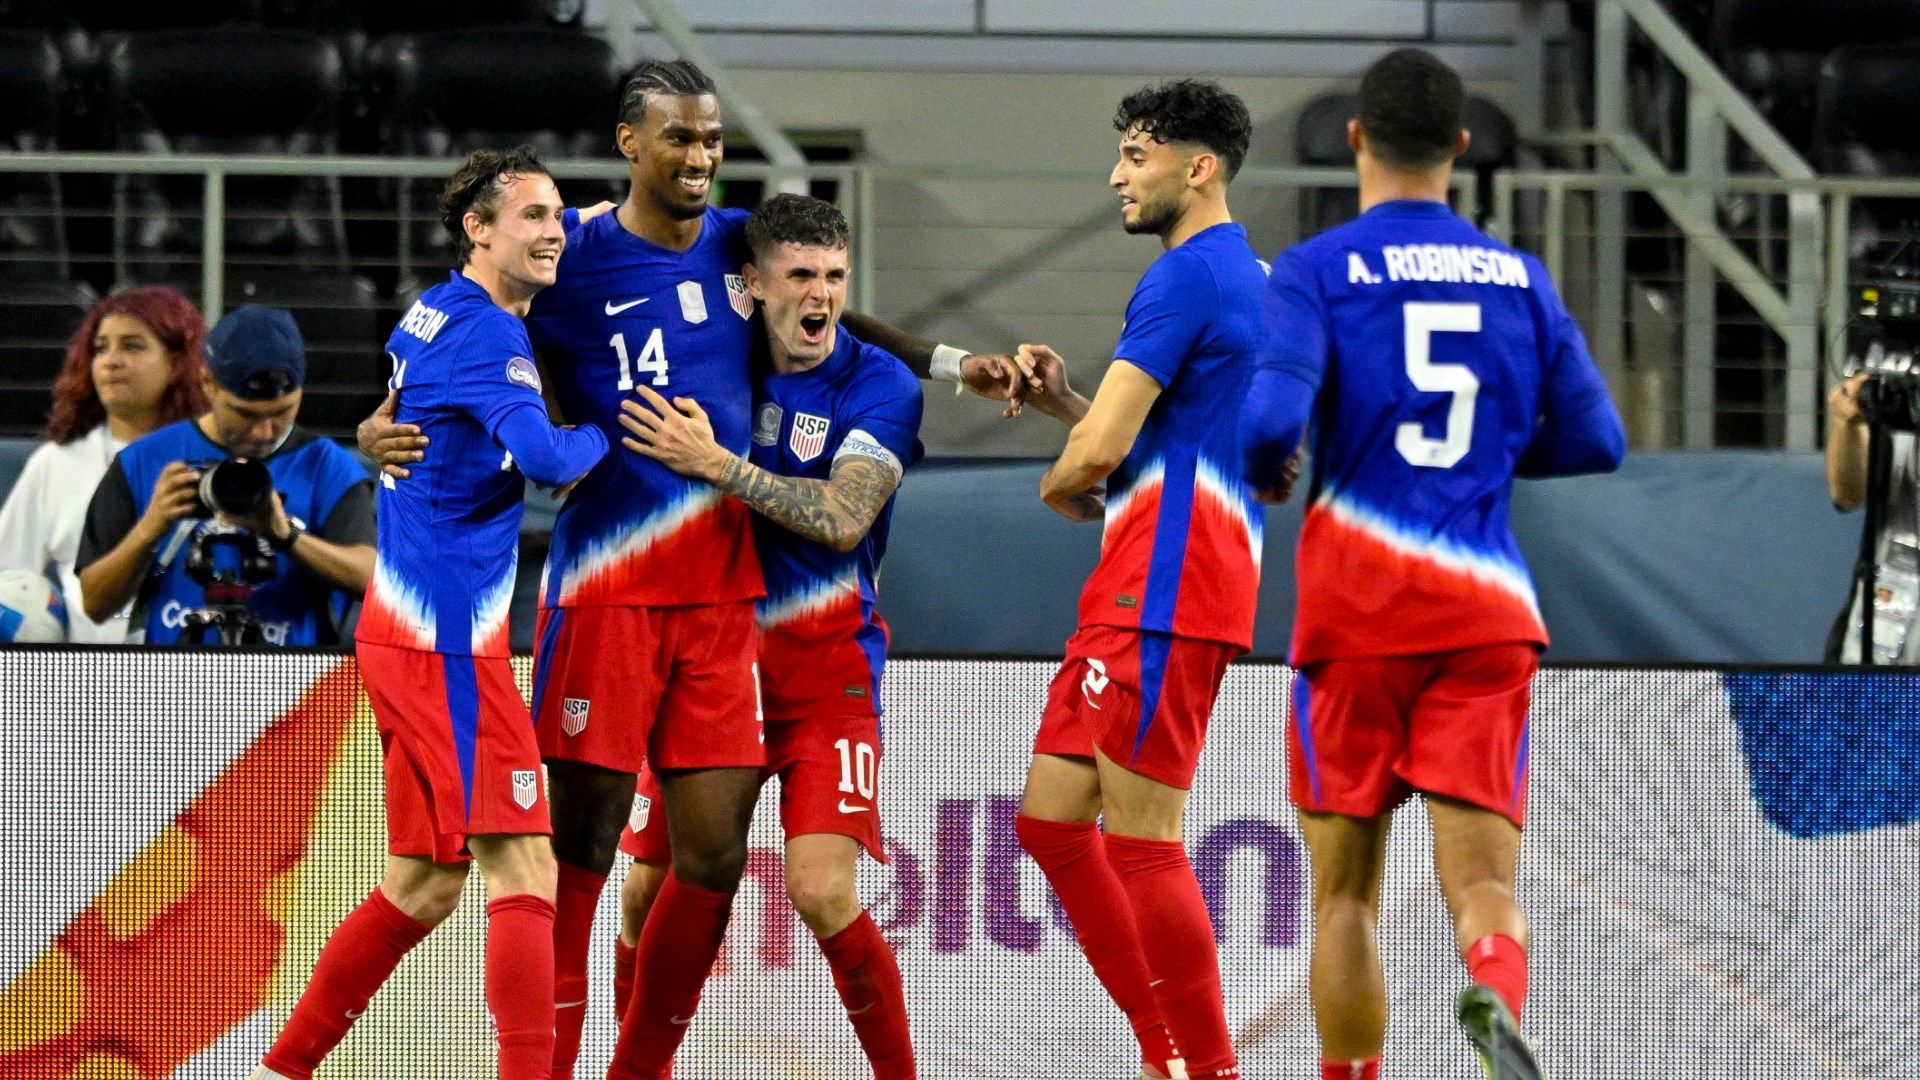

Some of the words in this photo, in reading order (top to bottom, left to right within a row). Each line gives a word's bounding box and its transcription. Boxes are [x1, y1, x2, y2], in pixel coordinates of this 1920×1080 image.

[1348, 252, 1382, 284] A.
[1382, 243, 1530, 288] ROBINSON
[609, 328, 669, 391] 14
[1394, 301, 1482, 468] 5
[796, 415, 828, 436] USA
[564, 699, 588, 715] USA
[514, 772, 535, 787] USA
[834, 738, 875, 801] 10
